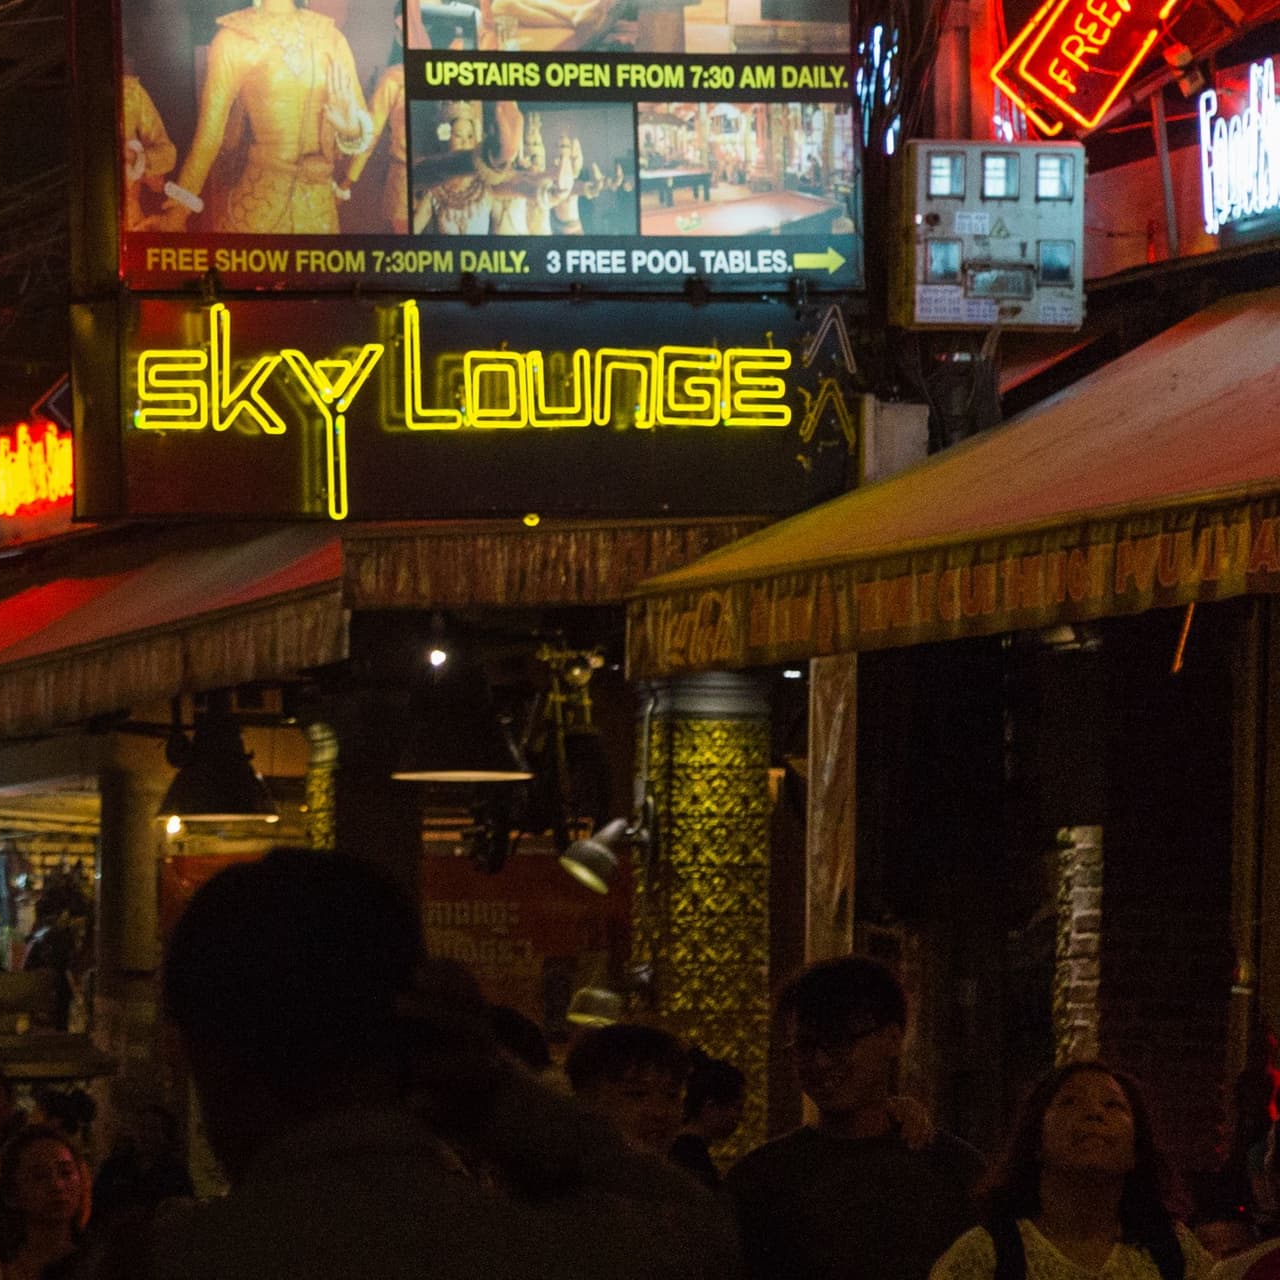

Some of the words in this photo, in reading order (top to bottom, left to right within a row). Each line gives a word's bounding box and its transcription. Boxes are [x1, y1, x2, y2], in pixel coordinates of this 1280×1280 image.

[424, 61, 540, 87] UPSTAIRS
[545, 63, 610, 88] OPEN
[616, 65, 684, 89] FROM
[690, 65, 735, 89] 7:30
[740, 66, 775, 89] AM
[781, 66, 849, 90] DAILY.
[146, 248, 209, 272] FREE
[214, 248, 289, 273] SHOW
[295, 248, 365, 273] FROM
[371, 249, 454, 274] 7:30PM
[460, 249, 530, 274] DAILY.
[546, 250, 561, 274] 3
[566, 250, 626, 274] FREE
[631, 250, 696, 275] POOL
[701, 250, 794, 276] TABLES.
